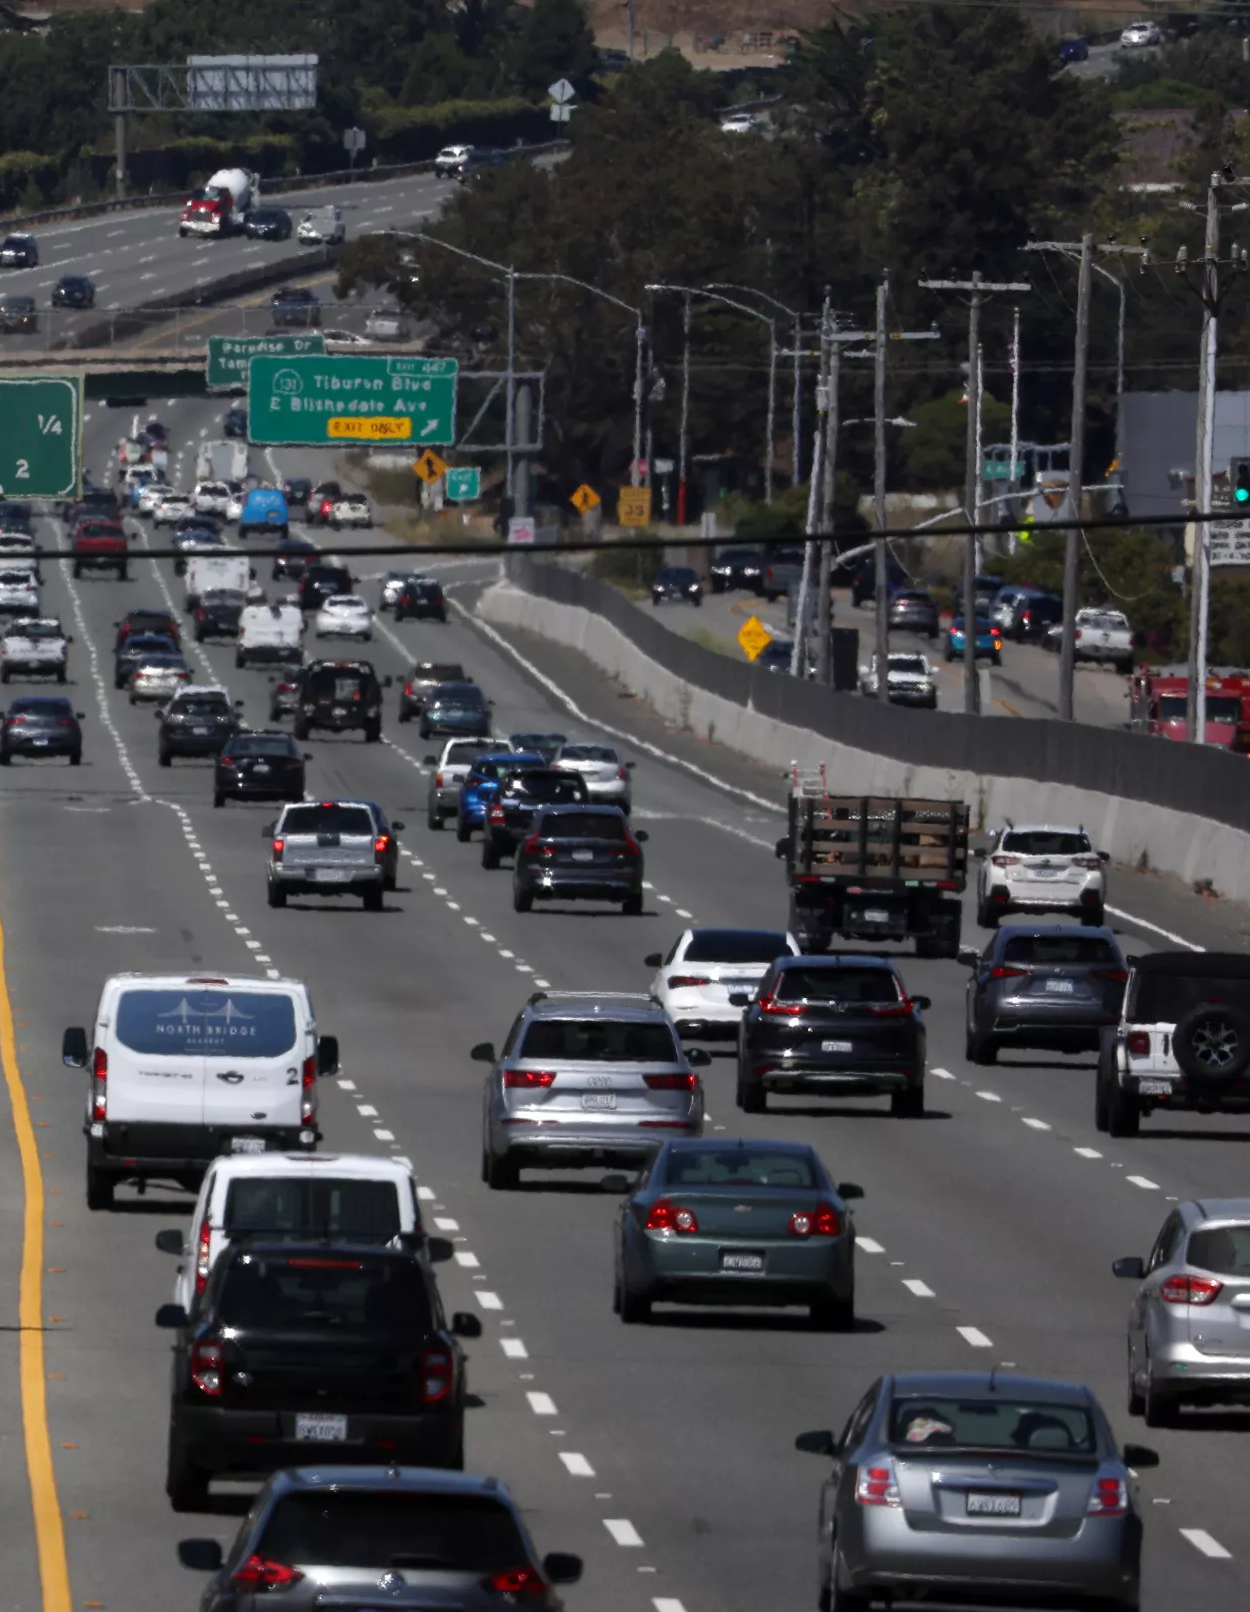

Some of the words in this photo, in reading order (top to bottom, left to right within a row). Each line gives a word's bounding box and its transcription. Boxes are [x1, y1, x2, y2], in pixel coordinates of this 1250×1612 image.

[222, 341, 285, 354] Paradise
[293, 339, 312, 350] Dr
[278, 377, 299, 391] 131
[313, 375, 384, 391] Tiburon
[391, 376, 432, 391] Blvd
[269, 396, 281, 411] E
[290, 397, 386, 413] Blithedale
[393, 398, 428, 412] Ave
[333, 421, 363, 433] EXIT
[15, 459, 31, 479] 2
[156, 1024, 200, 1035] NORTH
[206, 1025, 257, 1036] BRIDGE
[286, 1067, 299, 1086] 2
